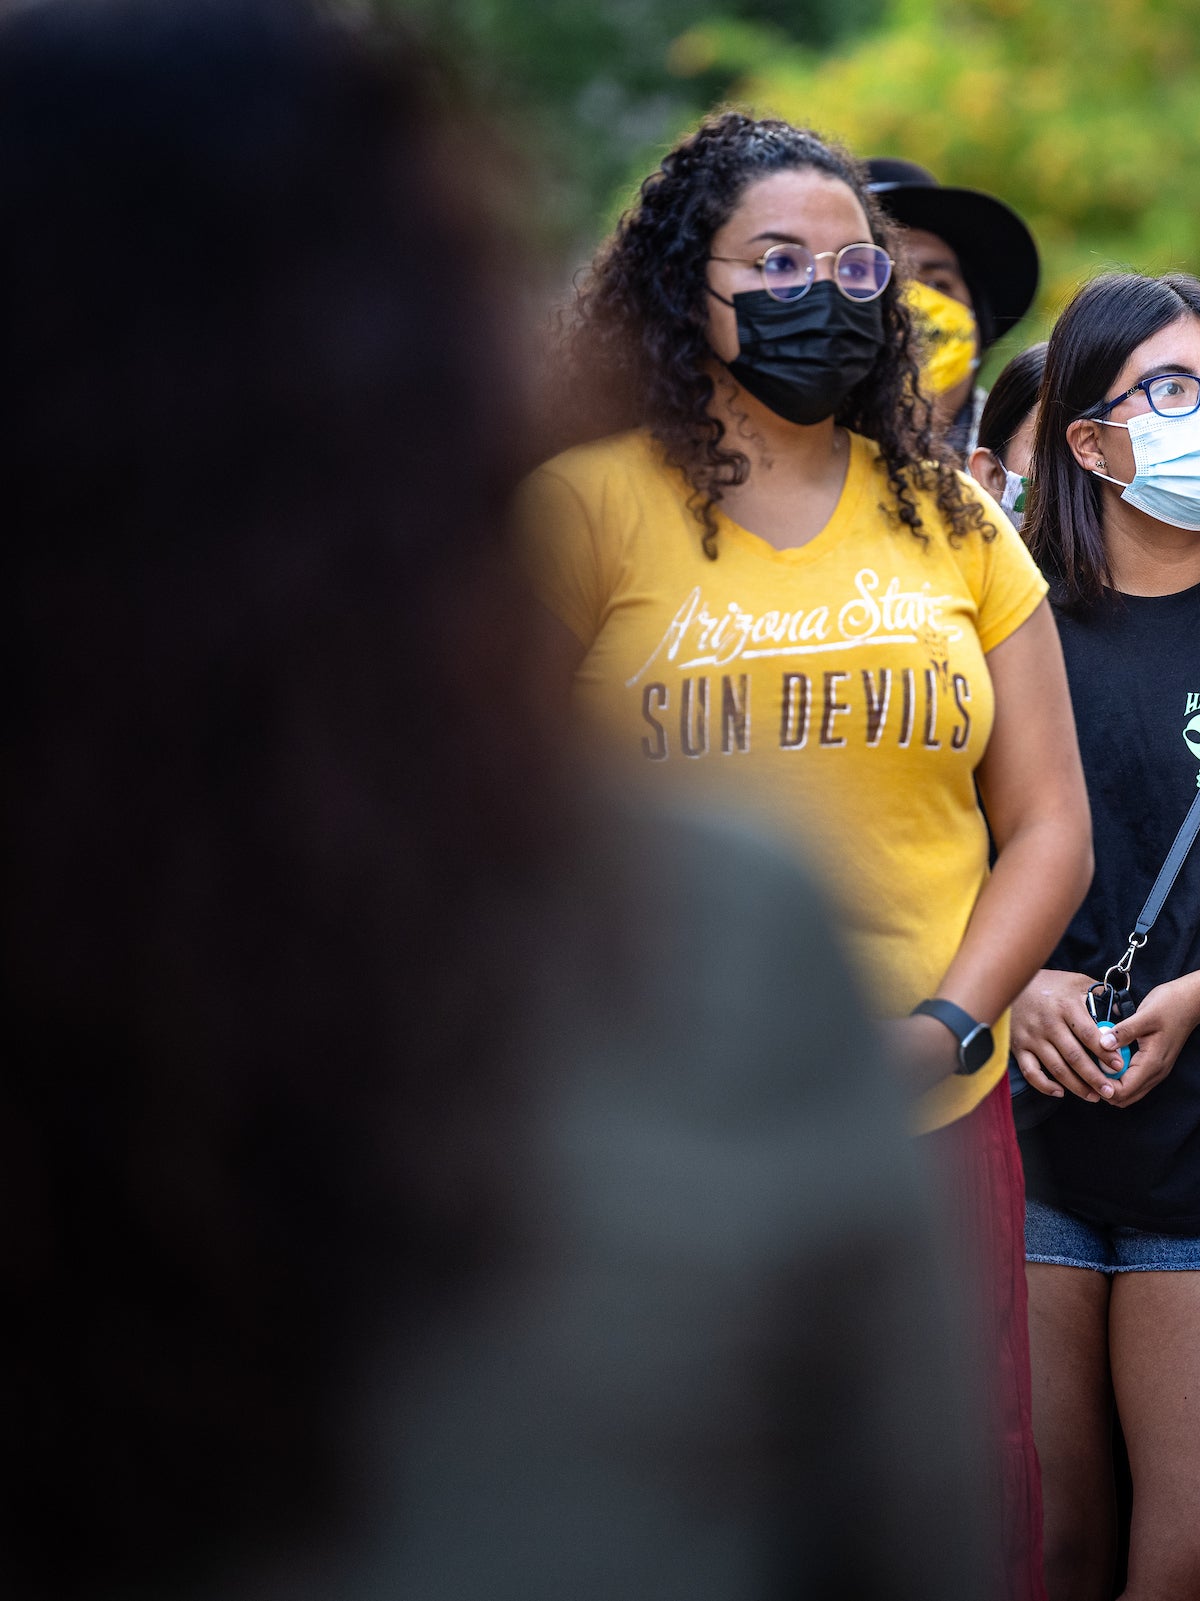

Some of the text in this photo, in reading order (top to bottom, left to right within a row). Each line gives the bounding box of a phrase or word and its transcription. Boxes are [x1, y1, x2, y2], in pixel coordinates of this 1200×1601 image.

[625, 567, 962, 688] Arizona State
[642, 667, 972, 762] SUN DEVILS
